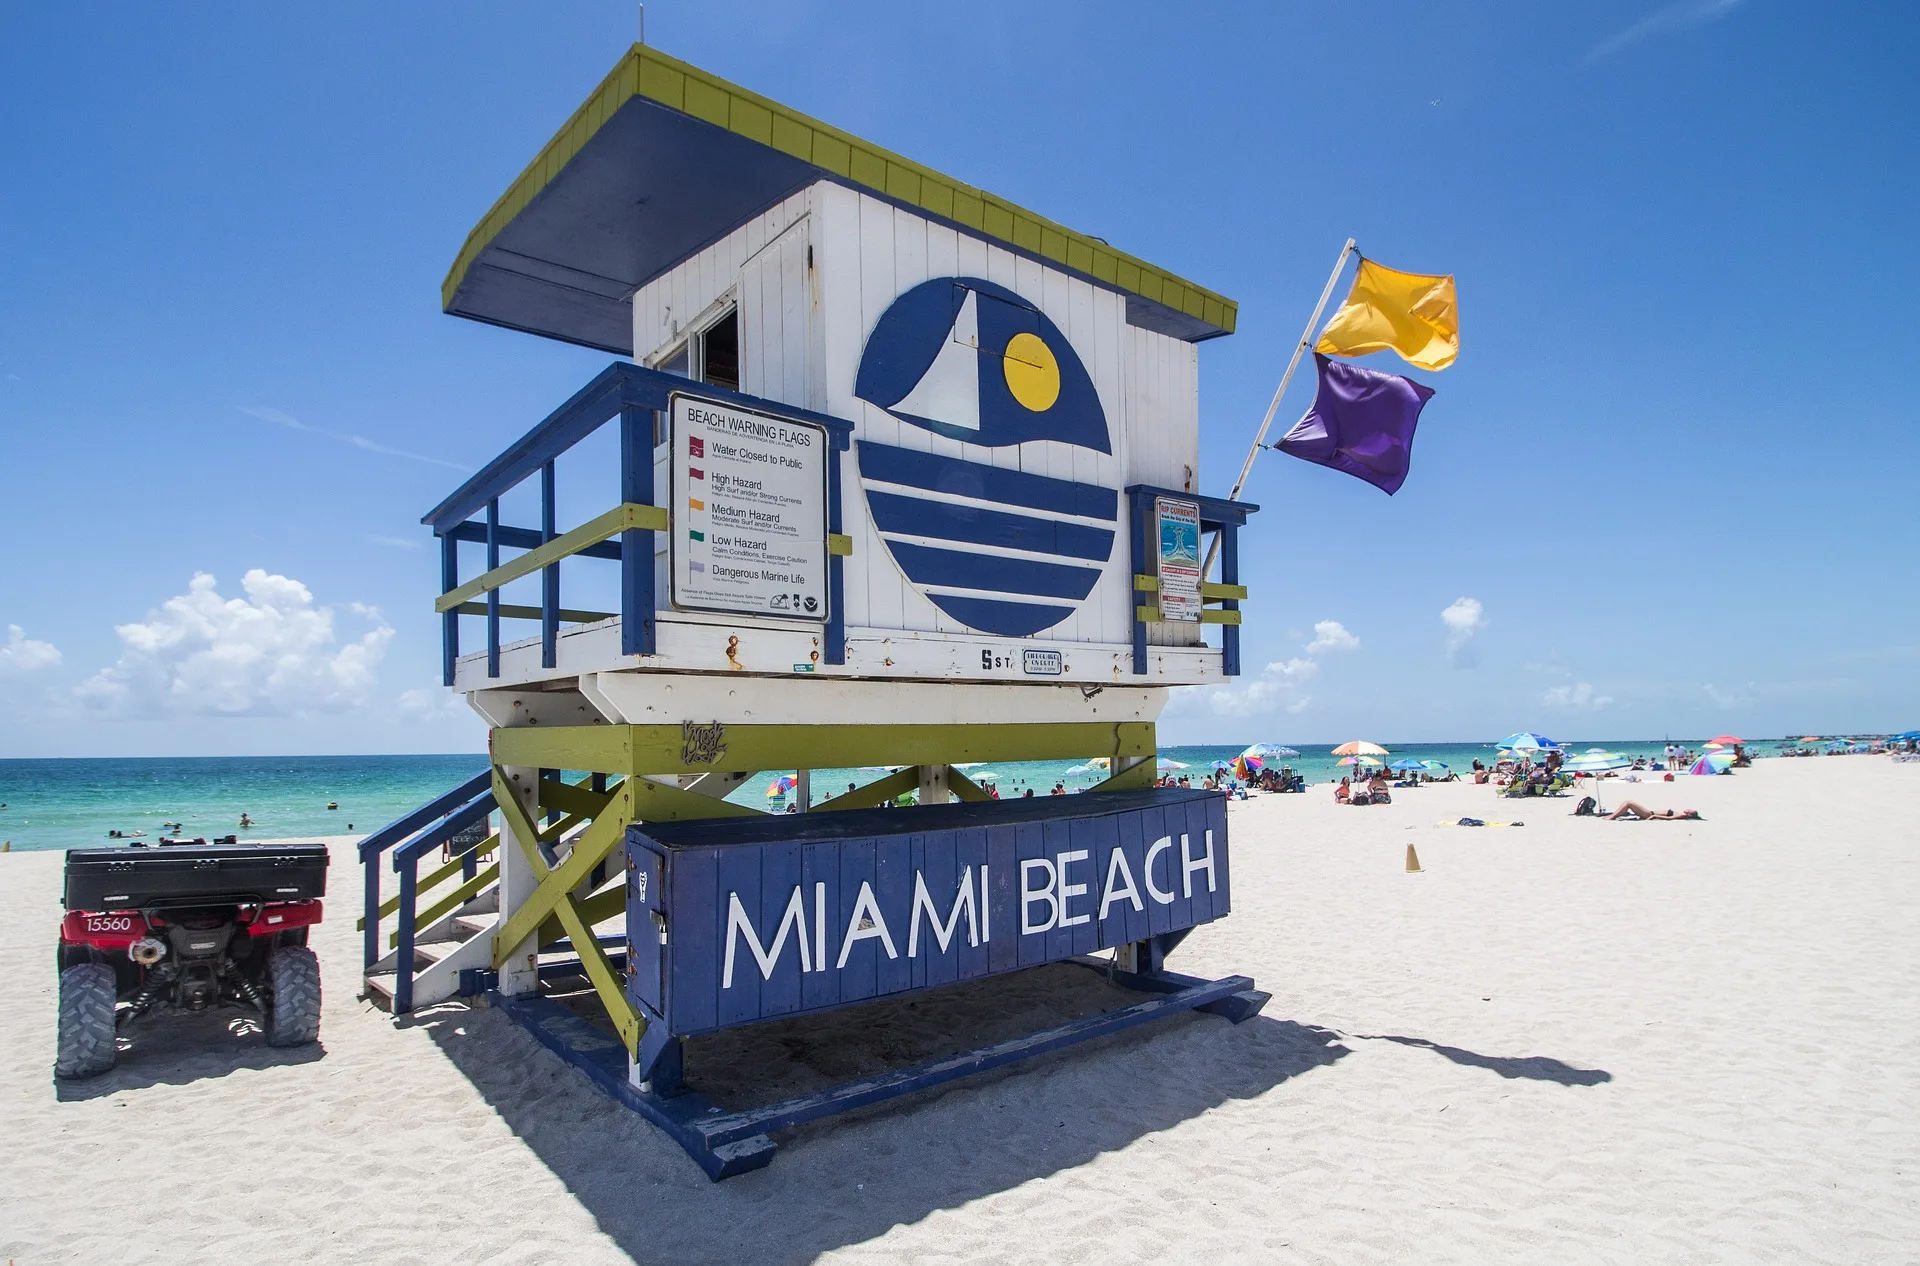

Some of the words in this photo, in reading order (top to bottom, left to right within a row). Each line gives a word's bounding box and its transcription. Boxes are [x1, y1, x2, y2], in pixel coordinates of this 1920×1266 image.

[688, 408, 725, 428] BEACH
[728, 417, 776, 439] WARNING
[780, 428, 810, 446] FLAGS
[707, 426, 731, 435] BANDERAS
[739, 433, 768, 443] ADVERTENCIA
[712, 442, 737, 456] Water
[740, 448, 767, 463] Closed
[770, 454, 777, 464] to
[780, 456, 802, 469] Public
[712, 472, 730, 488] High
[733, 476, 762, 490] Hazard
[712, 484, 725, 492] High
[740, 488, 758, 497] and/or
[760, 492, 778, 502] Strong
[779, 496, 802, 505] Currents
[712, 503, 746, 518] Medium
[750, 509, 780, 523] Hazard
[1171, 507, 1196, 518] CURRENTS
[712, 514, 739, 524] Moderate
[774, 523, 796, 532] Currents
[712, 534, 731, 546] Low
[735, 537, 766, 550] Hazard
[729, 548, 760, 558] Conditions,
[762, 553, 786, 561] Exercise
[787, 556, 807, 564] Caution
[712, 565, 759, 579] Dangerous
[762, 571, 788, 582] Marine
[791, 574, 805, 584] Life
[995, 657, 1010, 668] ST
[722, 864, 990, 990] MIAMI
[1020, 828, 1218, 936] BEACH
[87, 917, 131, 932] 15560
